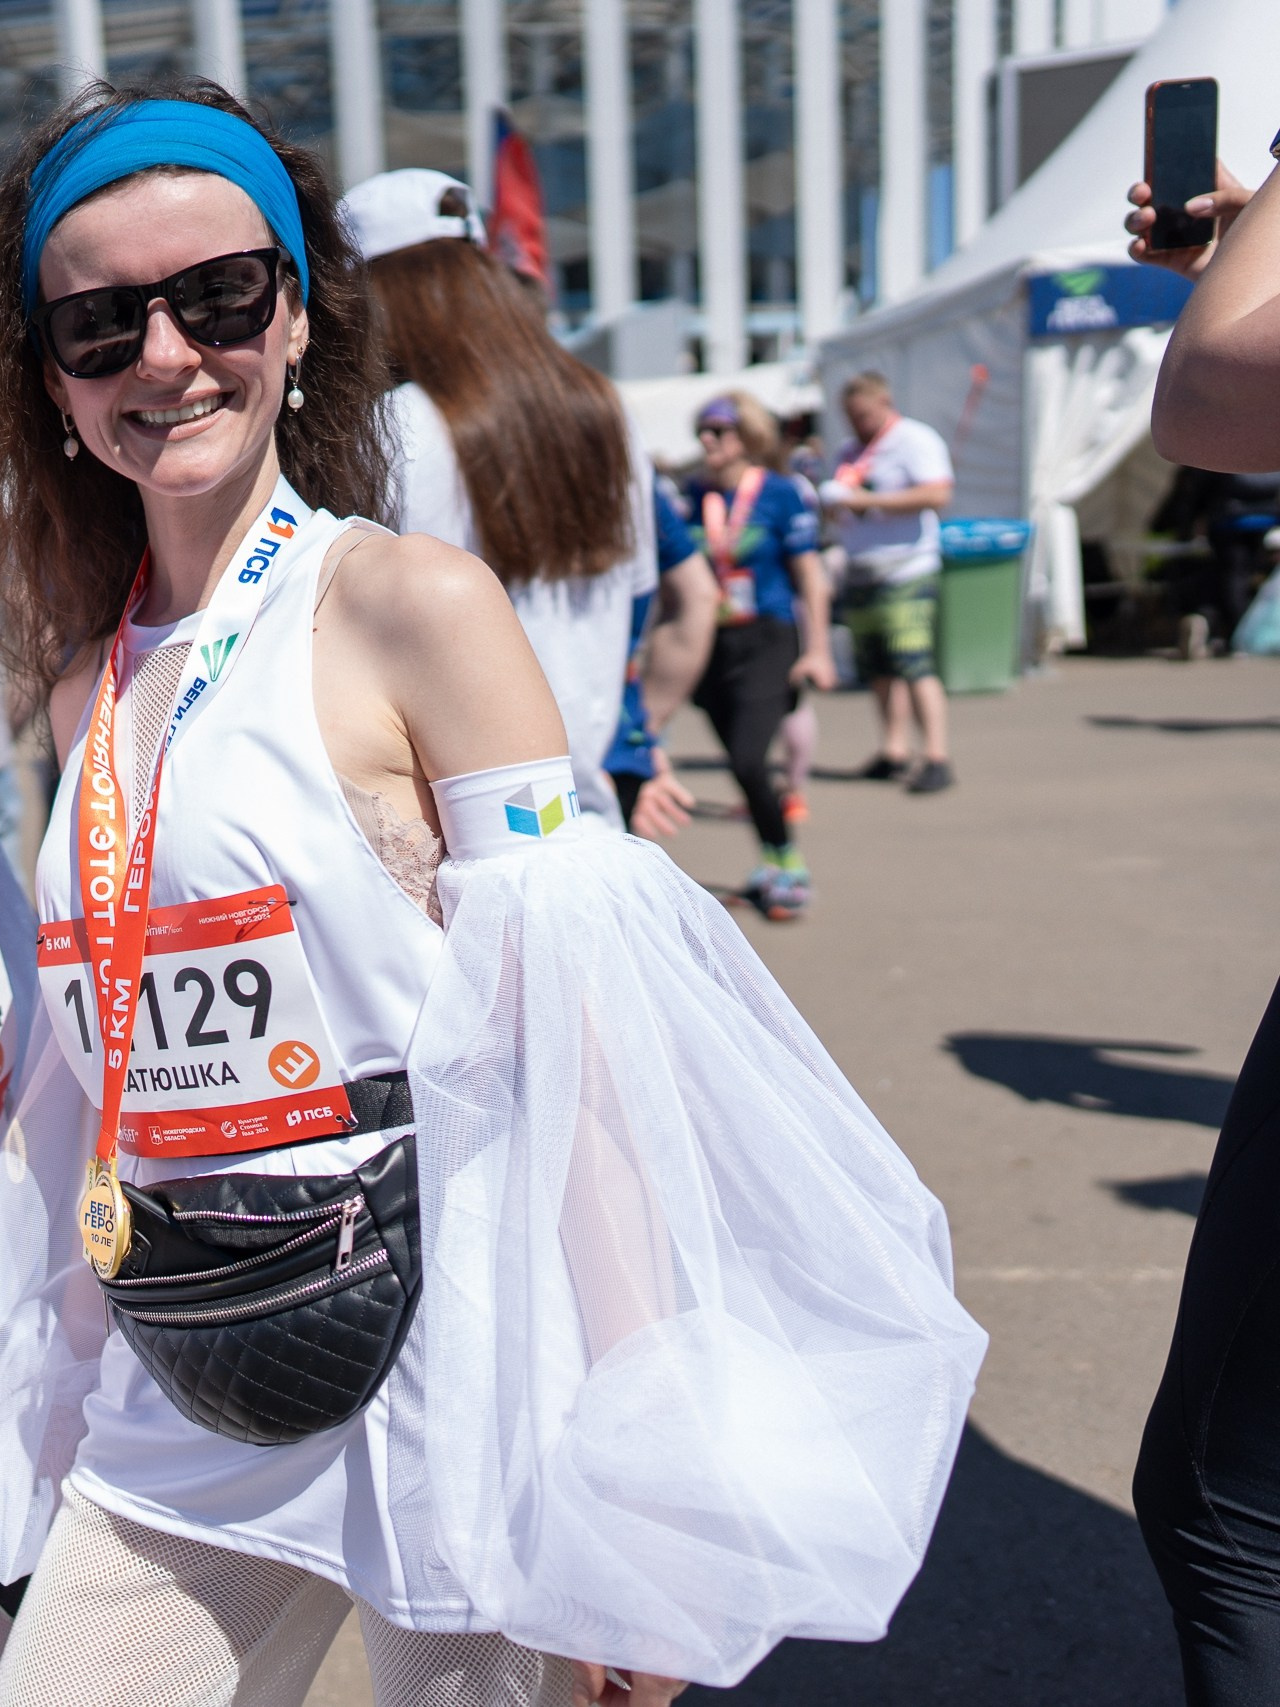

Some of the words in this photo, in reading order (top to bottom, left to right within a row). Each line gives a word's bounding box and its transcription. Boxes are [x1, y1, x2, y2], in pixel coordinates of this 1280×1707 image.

[238, 537, 282, 585] ПСБ
[89, 825, 116, 927] ЭТОТ
[123, 1060, 241, 1093] АТЮШКА
[304, 1106, 334, 1121] ПСБ
[101, 1237, 114, 1248] ЛЕ
